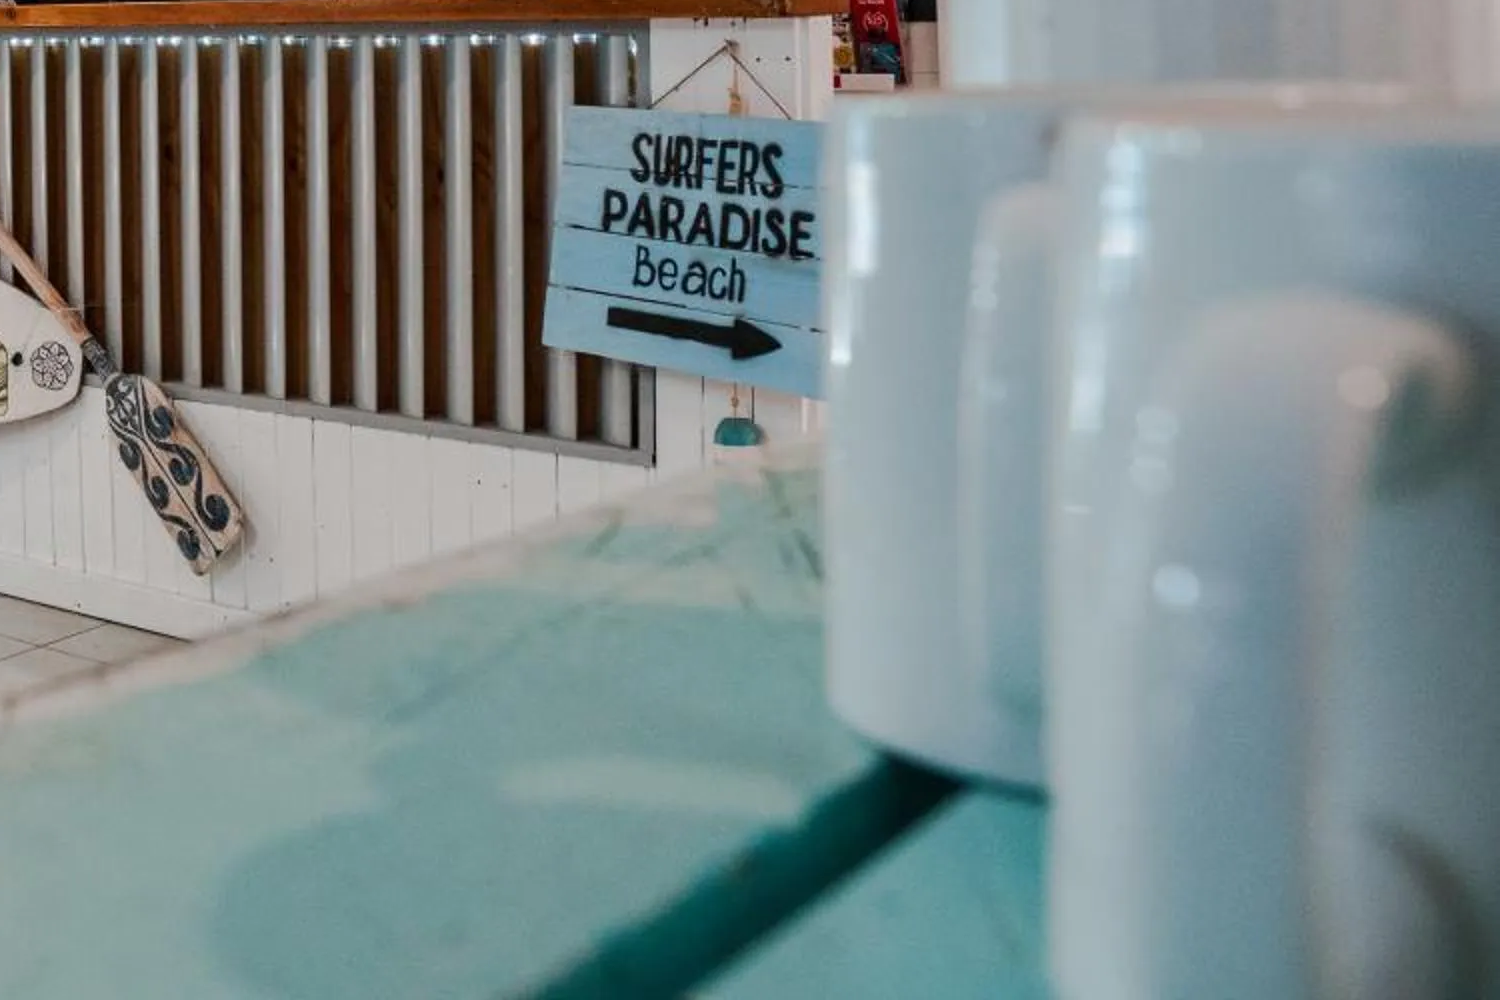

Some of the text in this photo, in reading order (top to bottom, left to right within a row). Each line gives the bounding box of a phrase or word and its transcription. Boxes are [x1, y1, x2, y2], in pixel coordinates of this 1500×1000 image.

[629, 132, 785, 199] SURFERS
[600, 188, 817, 261] PARADISE
[632, 244, 747, 304] Beach
